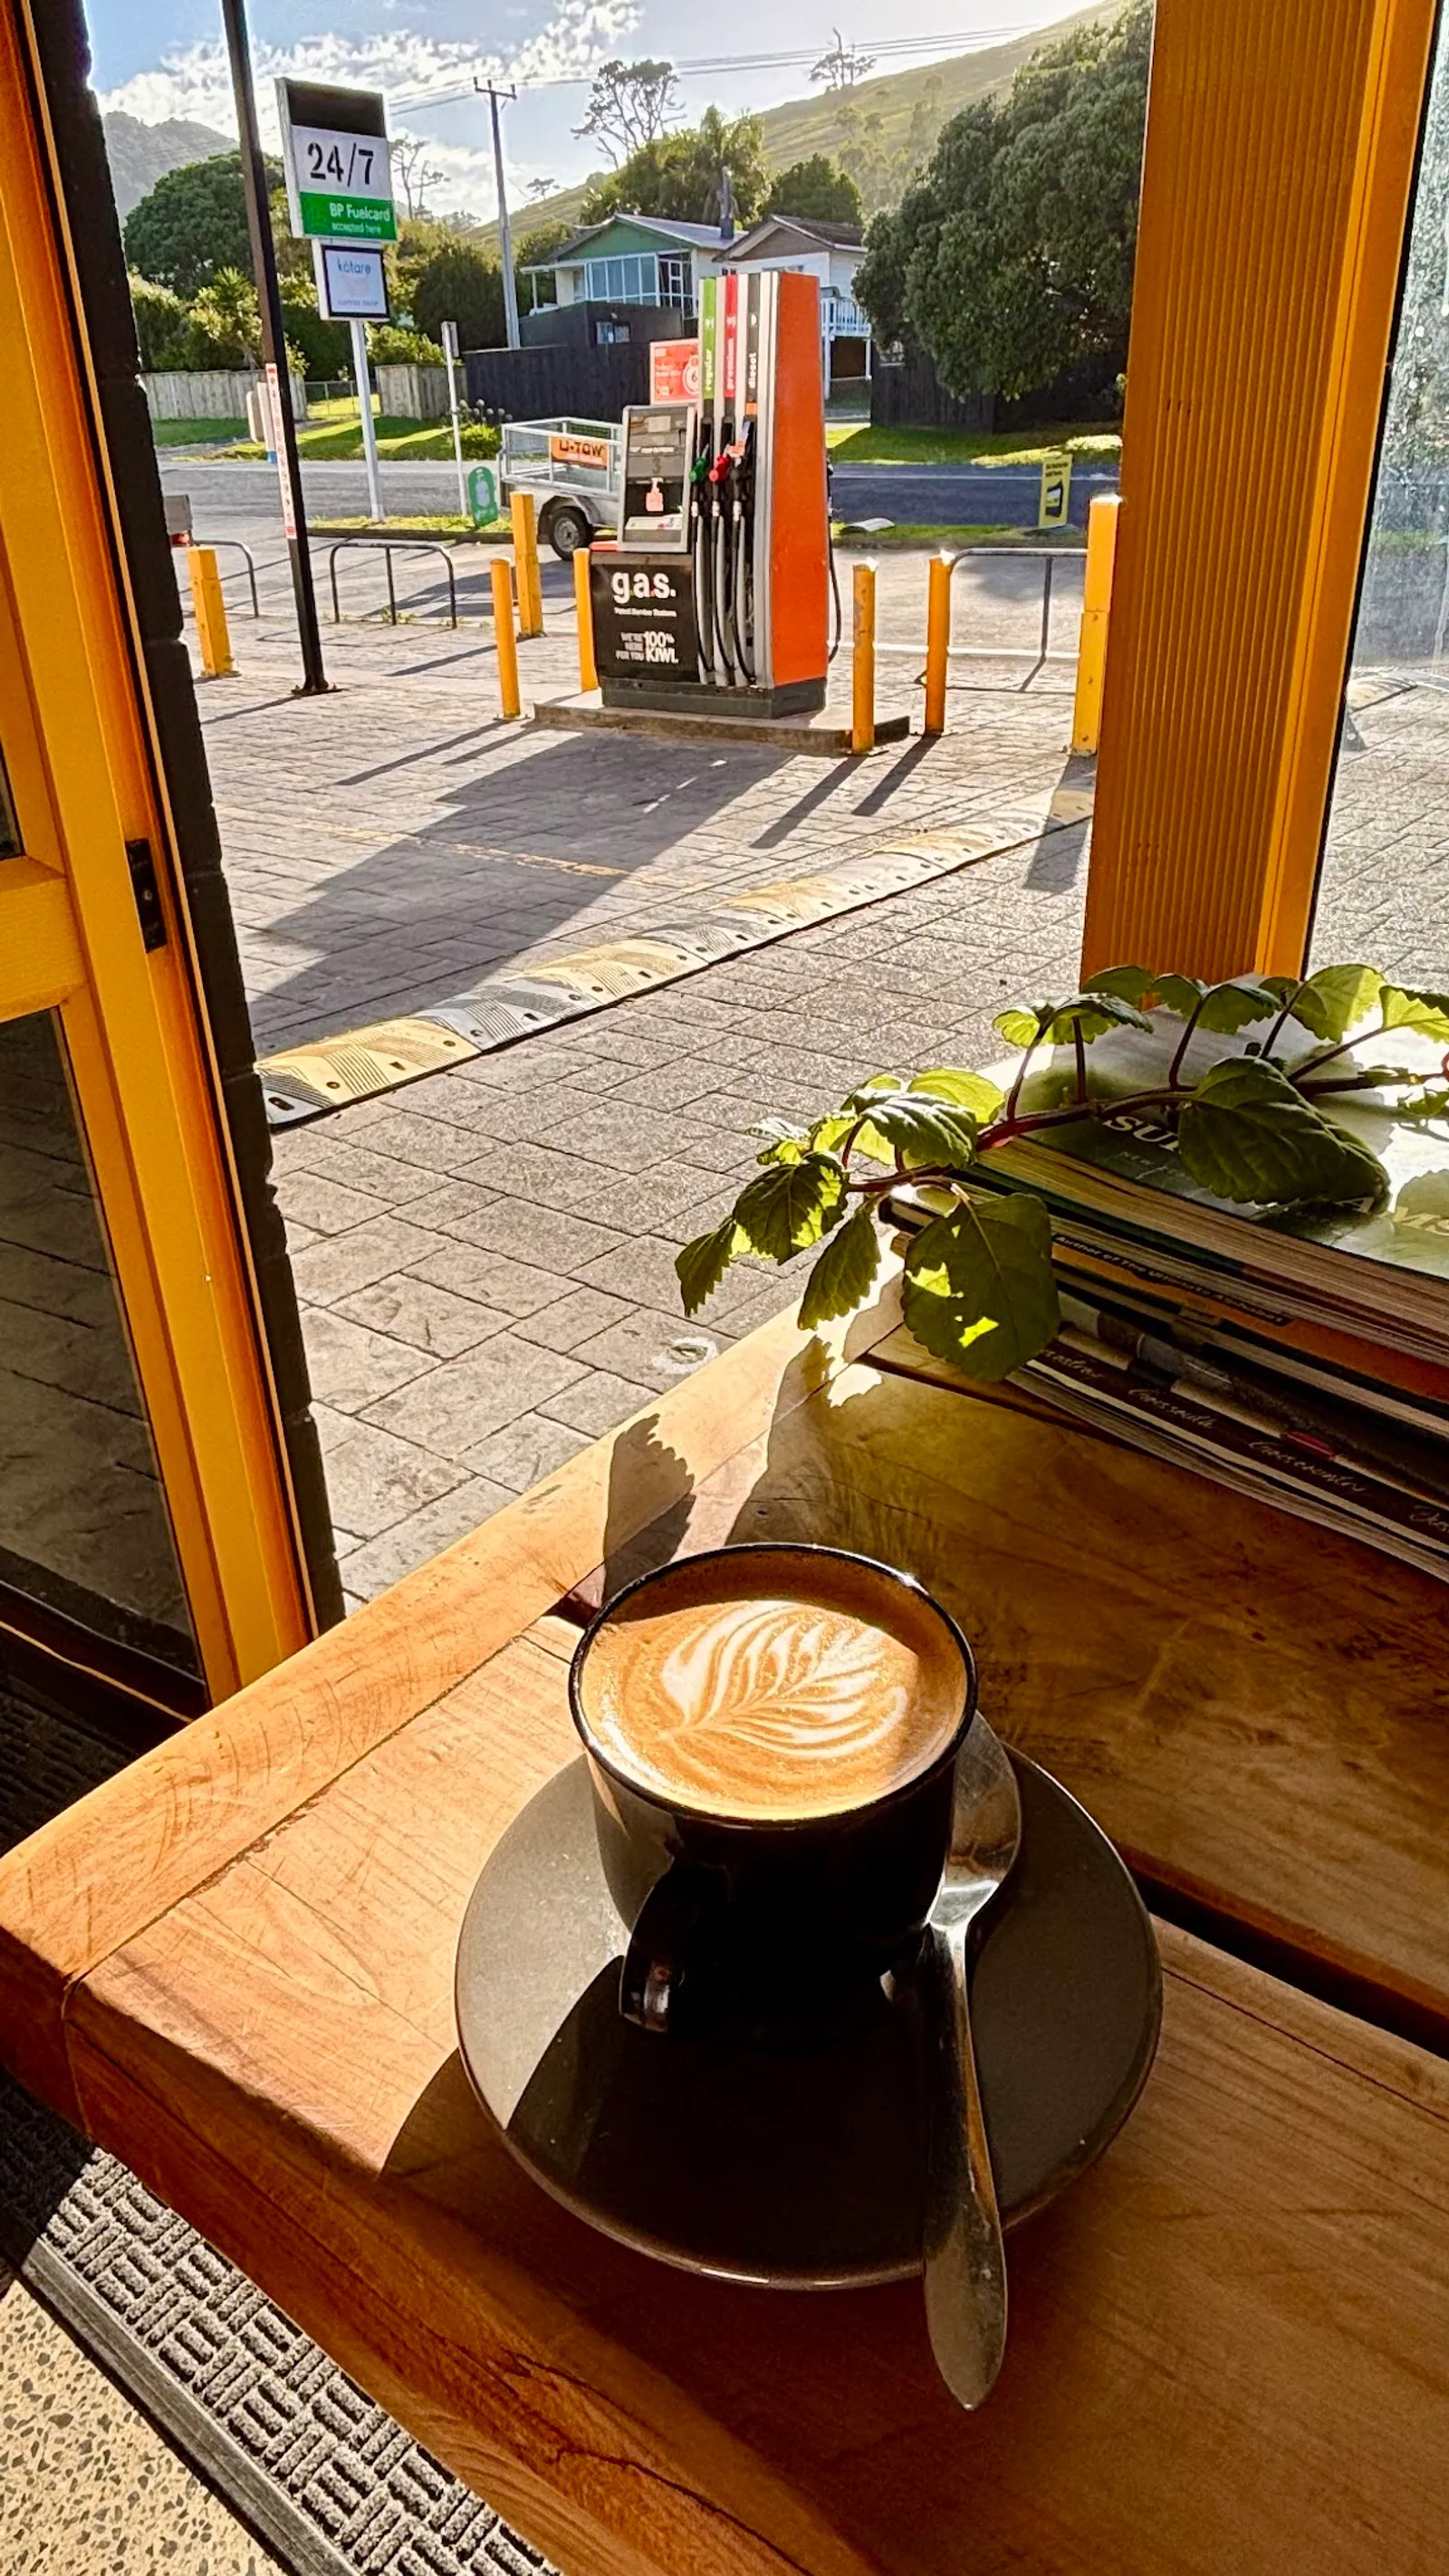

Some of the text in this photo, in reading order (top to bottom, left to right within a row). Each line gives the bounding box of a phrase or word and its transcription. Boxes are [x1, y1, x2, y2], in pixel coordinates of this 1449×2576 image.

[308, 141, 374, 187] 24/7
[330, 202, 391, 222] BP Fuelcard
[705, 349, 714, 391] regular
[749, 351, 757, 389] diesel
[643, 630, 676, 648] 100%
[1055, 1235, 1103, 1255] Author
